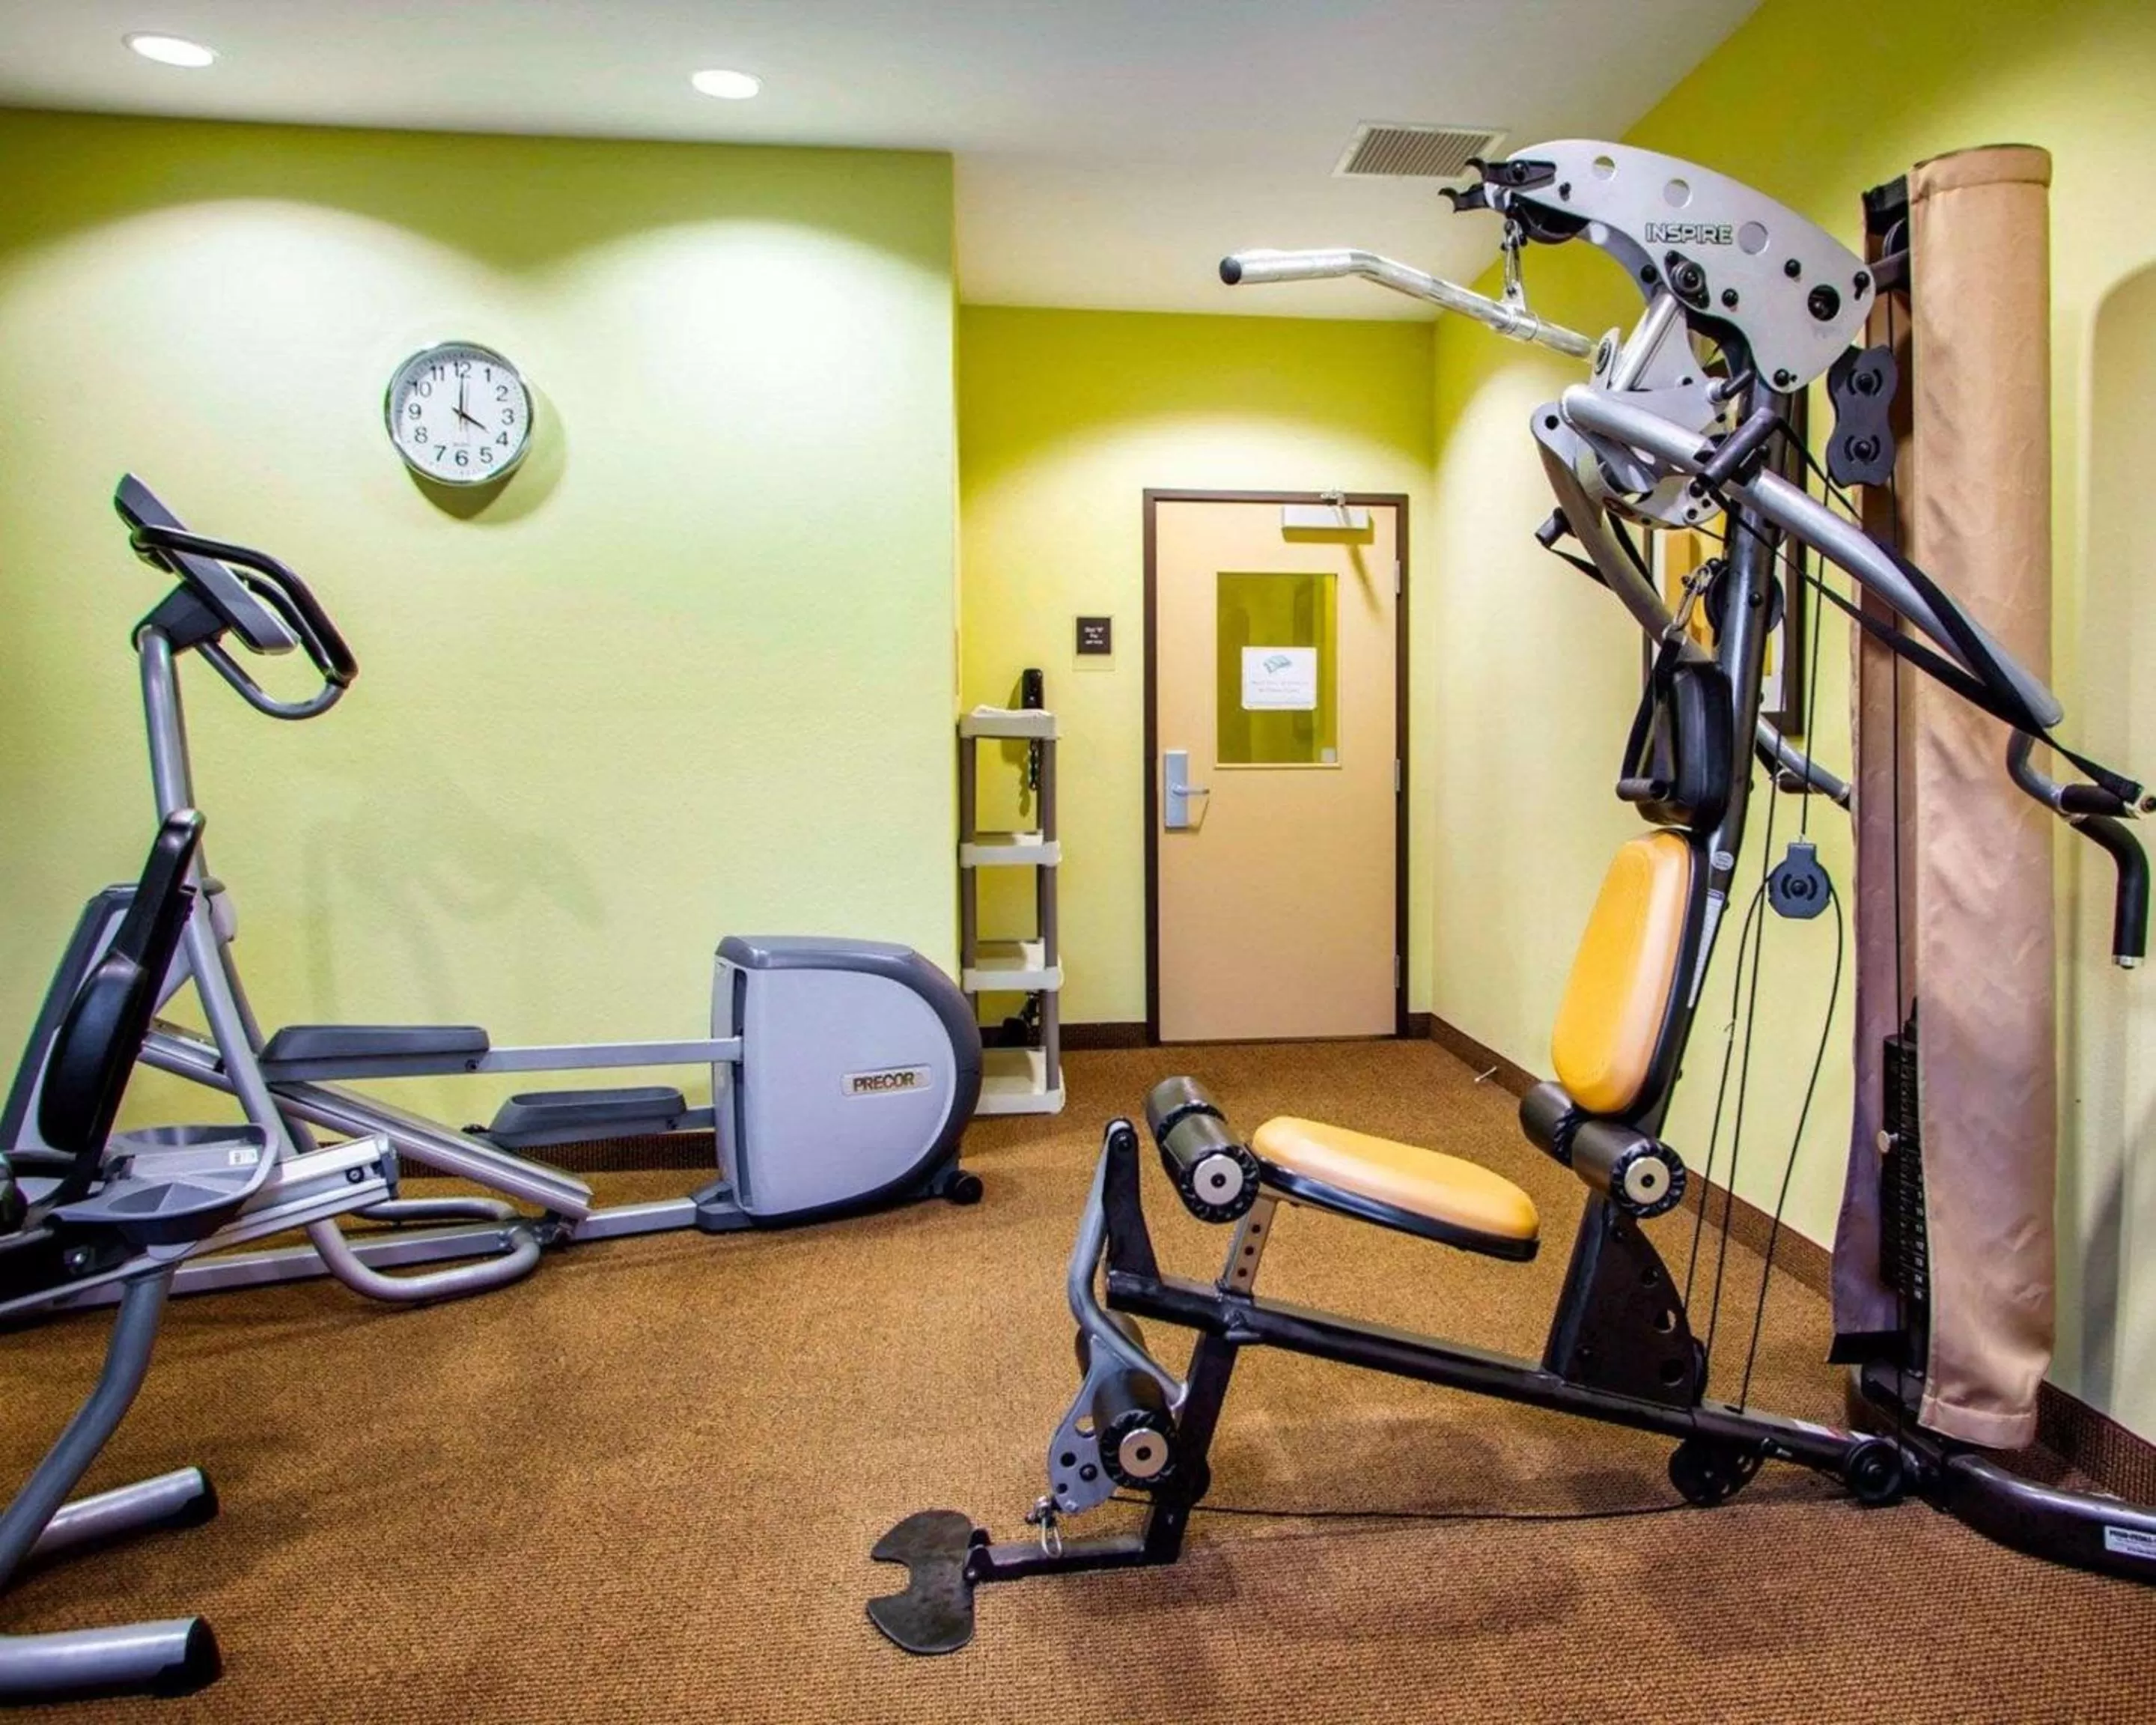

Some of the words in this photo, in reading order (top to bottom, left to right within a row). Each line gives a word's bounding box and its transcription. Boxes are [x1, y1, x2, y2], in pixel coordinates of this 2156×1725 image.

[1645, 222, 1732, 245] INSPIRE
[430, 365, 445, 381] 11
[454, 362, 472, 378] 12
[484, 368, 491, 383] 1
[411, 380, 432, 398] 10
[496, 385, 508, 402] 2
[408, 403, 421, 420] 9
[502, 408, 514, 425] 3
[415, 426, 428, 443] 8
[496, 431, 508, 446] 4
[433, 445, 446, 462] 7
[455, 450, 469, 466] 6
[479, 446, 493, 464] 5
[853, 1071, 914, 1092] PRECOR
